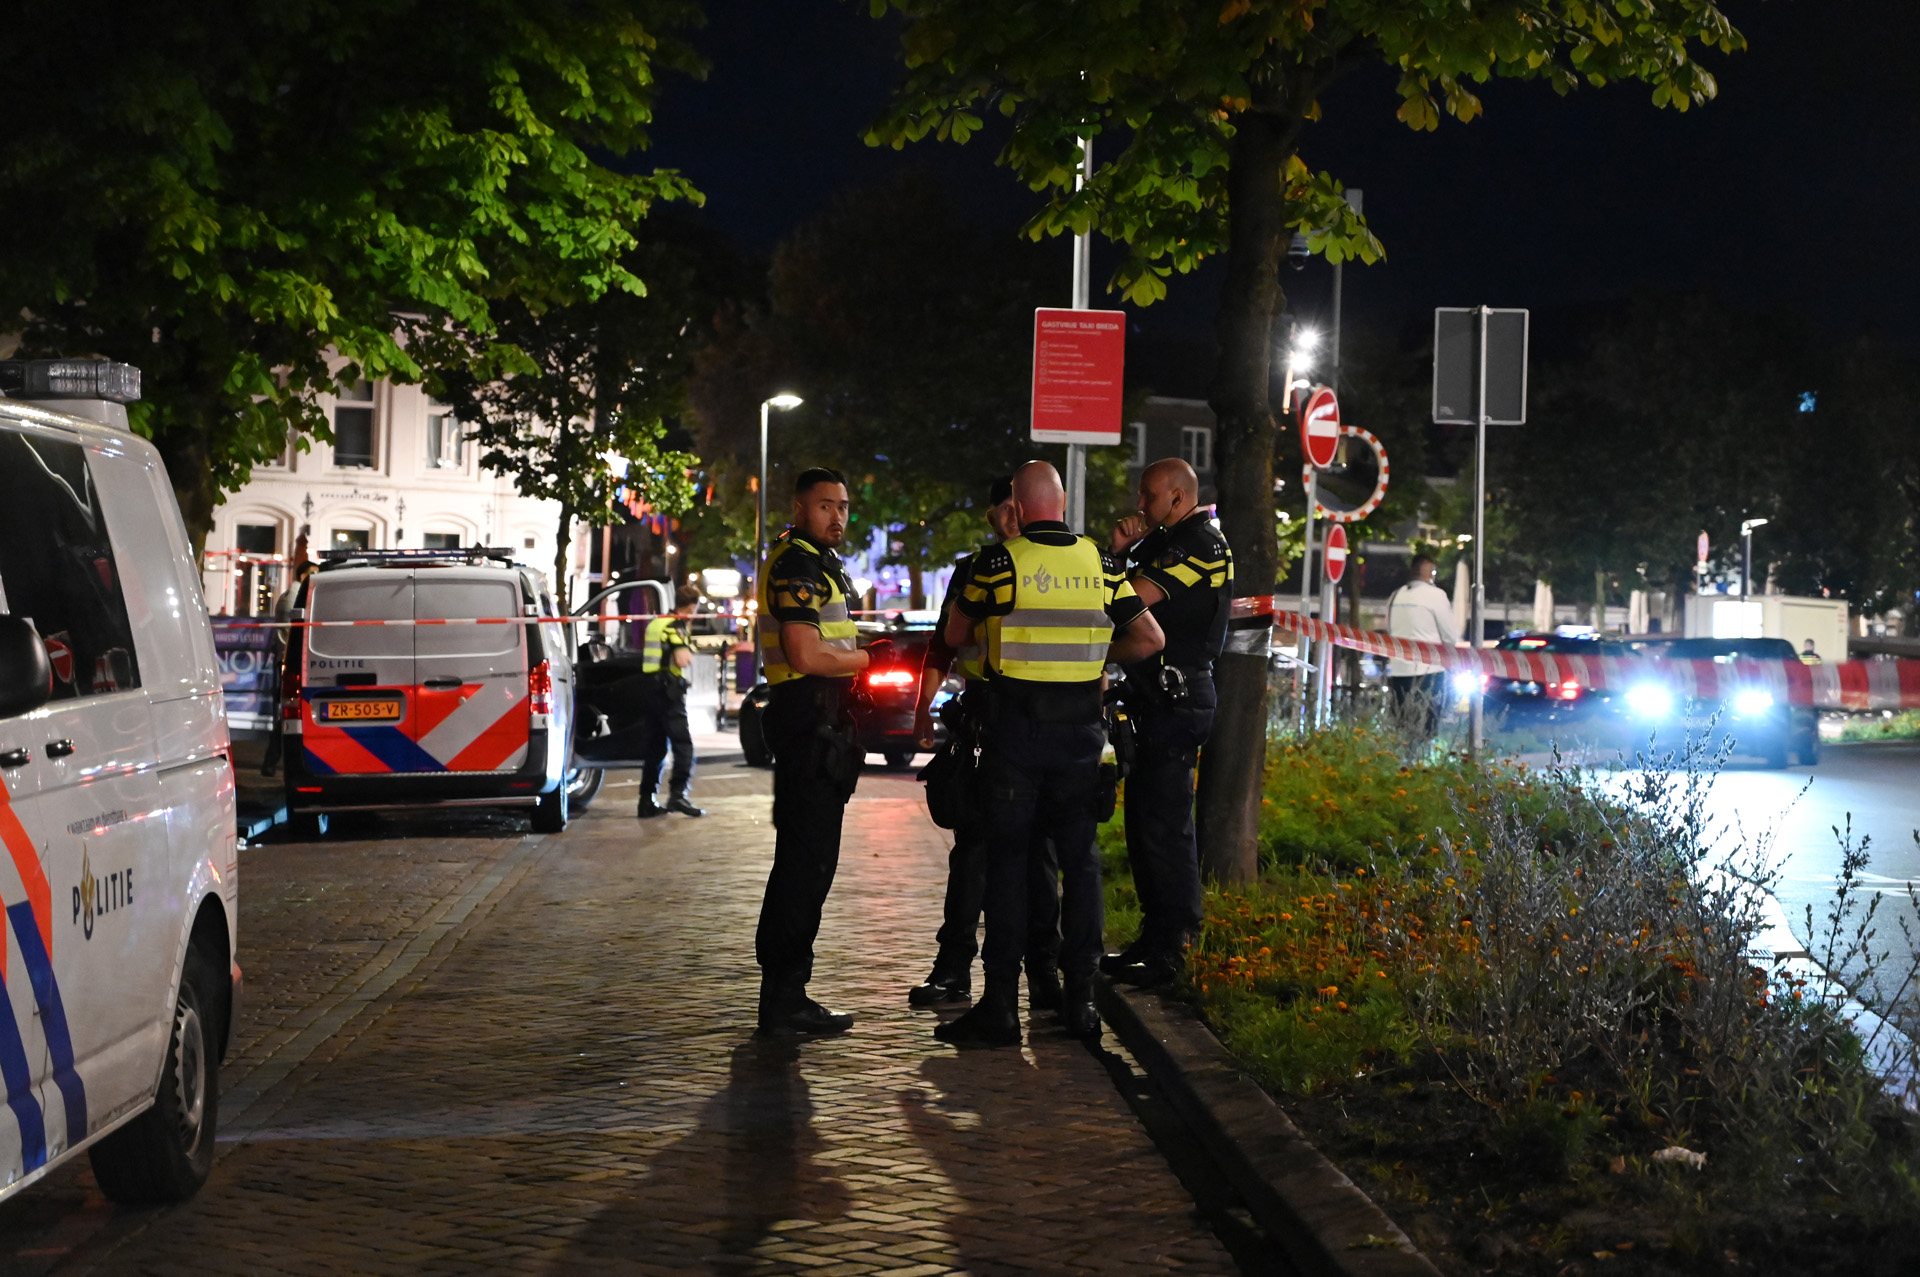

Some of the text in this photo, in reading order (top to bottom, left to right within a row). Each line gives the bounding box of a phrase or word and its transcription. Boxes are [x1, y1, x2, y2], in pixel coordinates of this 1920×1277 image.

[1022, 572, 1101, 594] POLITIE
[310, 660, 364, 668] POLITIE
[331, 703, 395, 717] ZR-505-V
[72, 864, 133, 941] POLITIE
